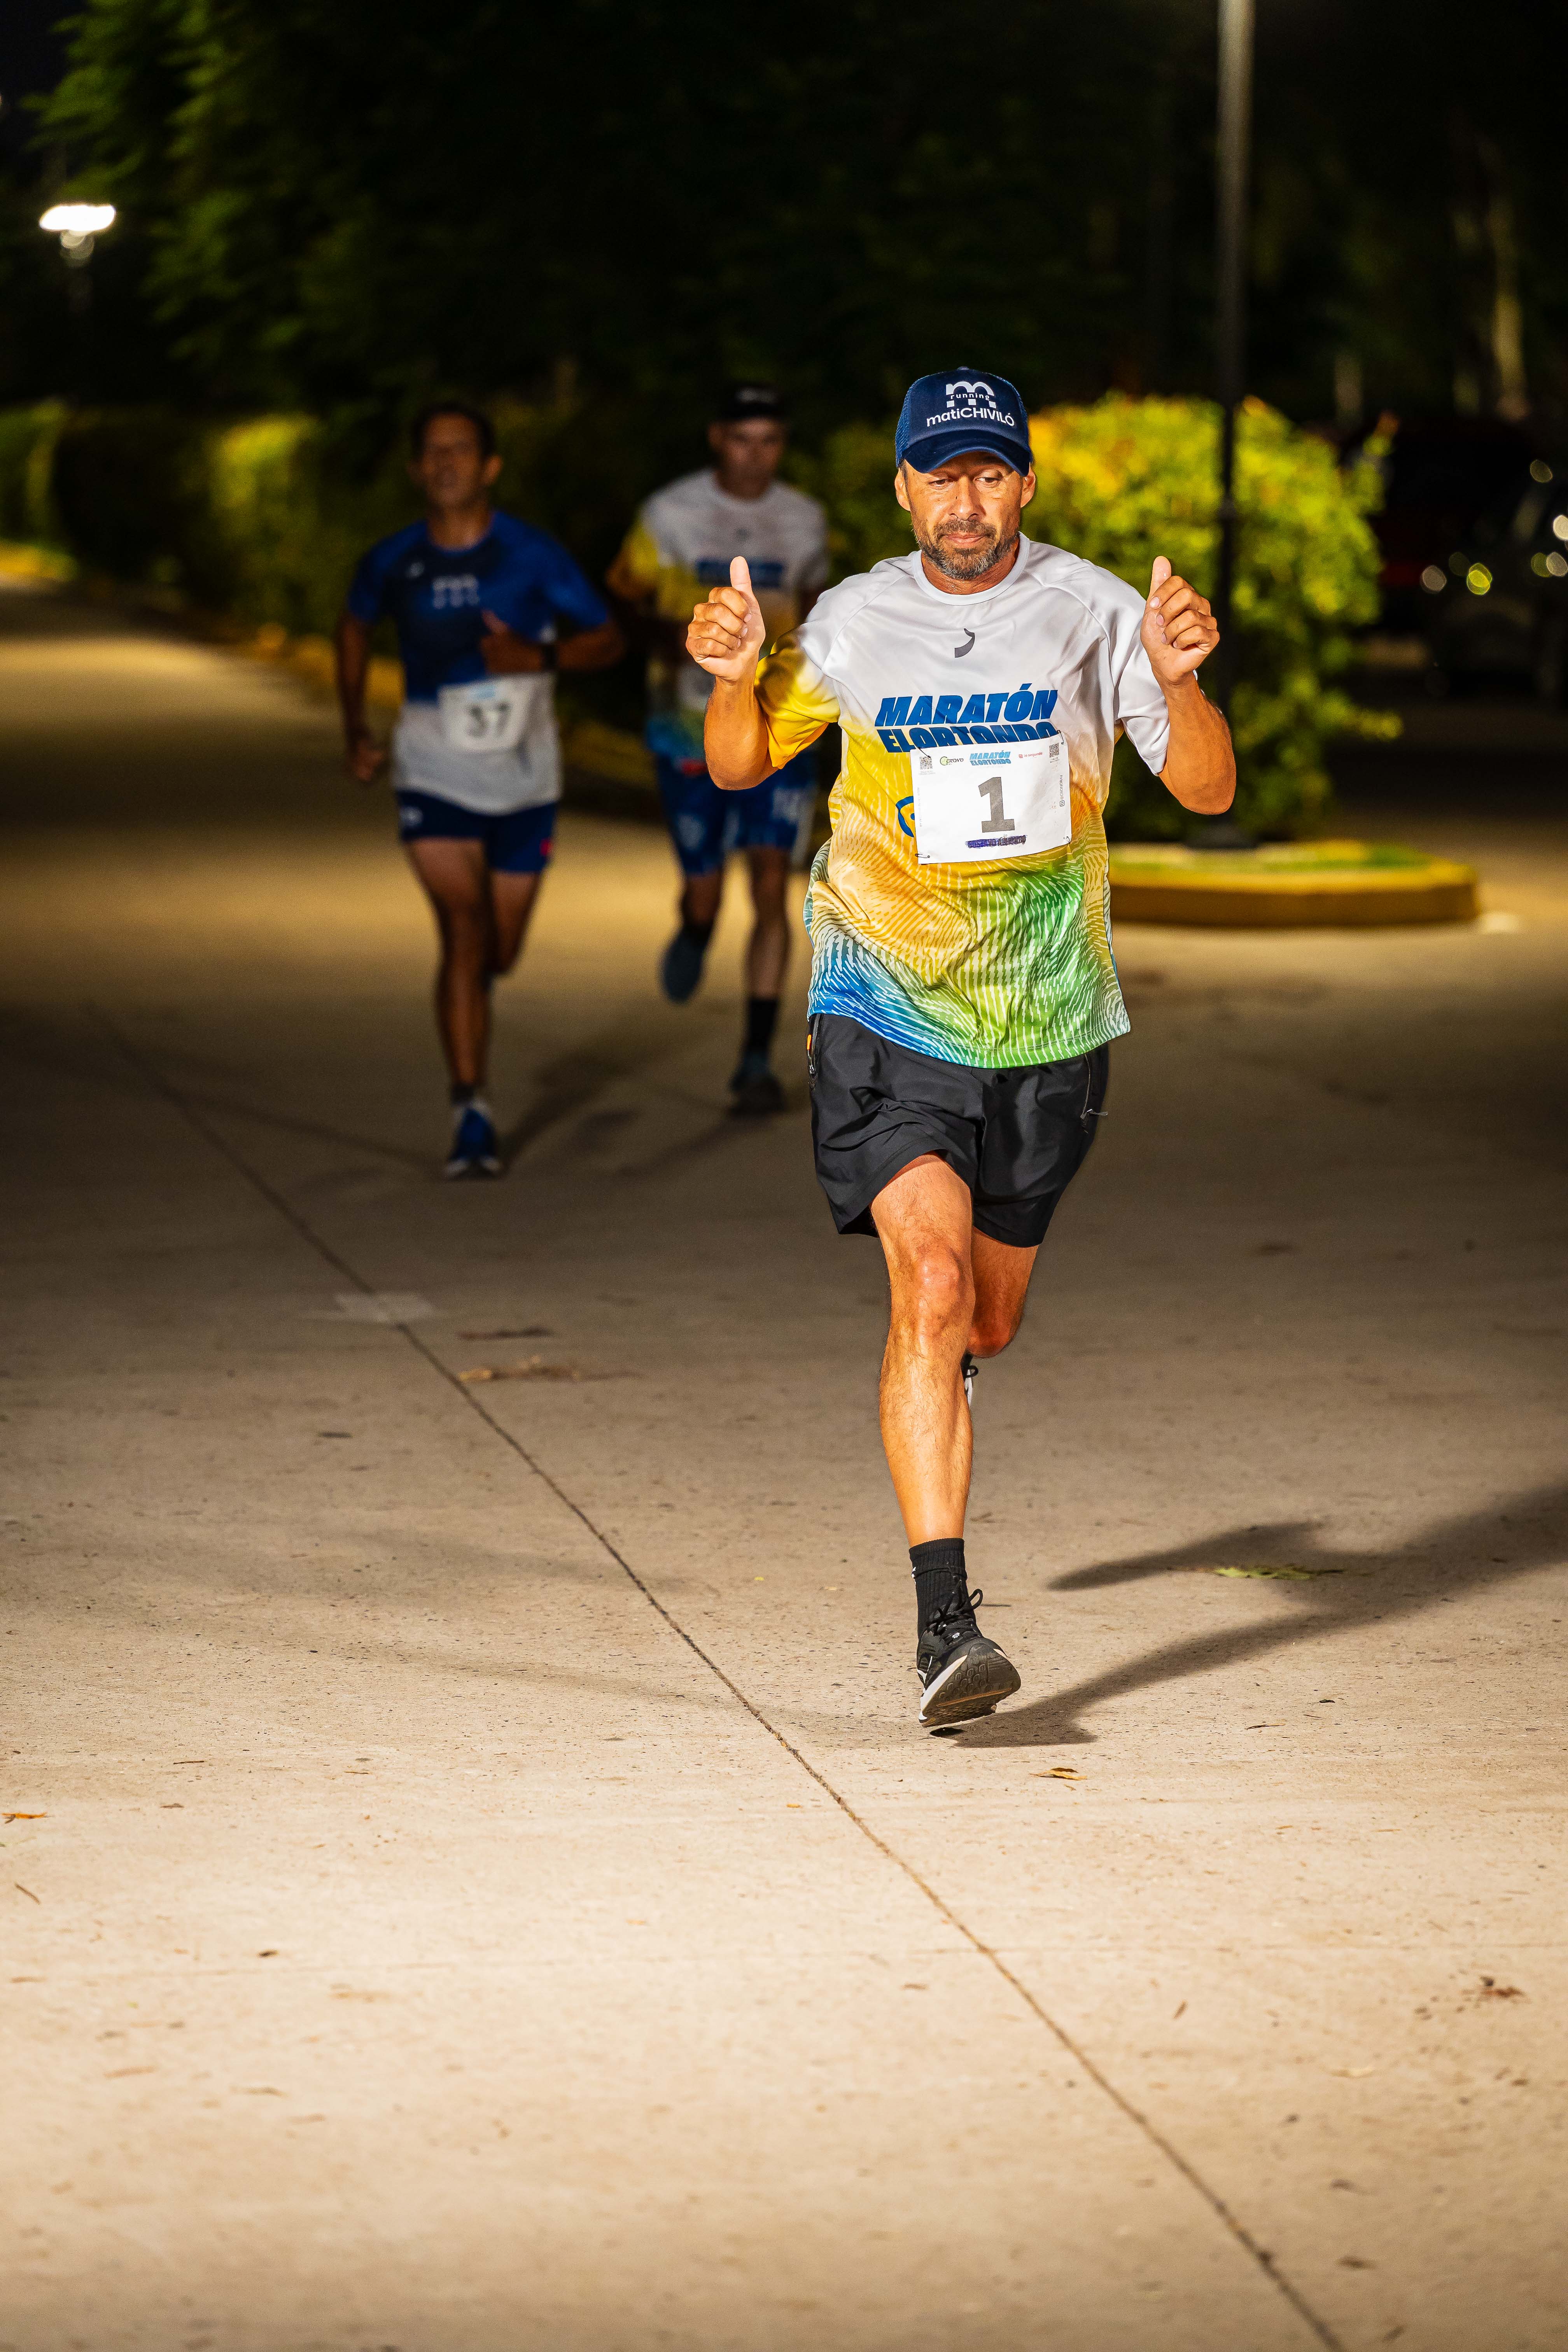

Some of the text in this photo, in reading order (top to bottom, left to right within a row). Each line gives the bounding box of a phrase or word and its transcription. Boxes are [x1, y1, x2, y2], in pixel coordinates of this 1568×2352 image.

[950, 392, 990, 401] running
[927, 408, 1015, 427] matiCHIVILÓ
[875, 683, 1058, 726] MARATÓN
[877, 722, 1057, 753] ELORTONDO
[970, 750, 1011, 760] MARATÓN
[978, 777, 1015, 833] 1
